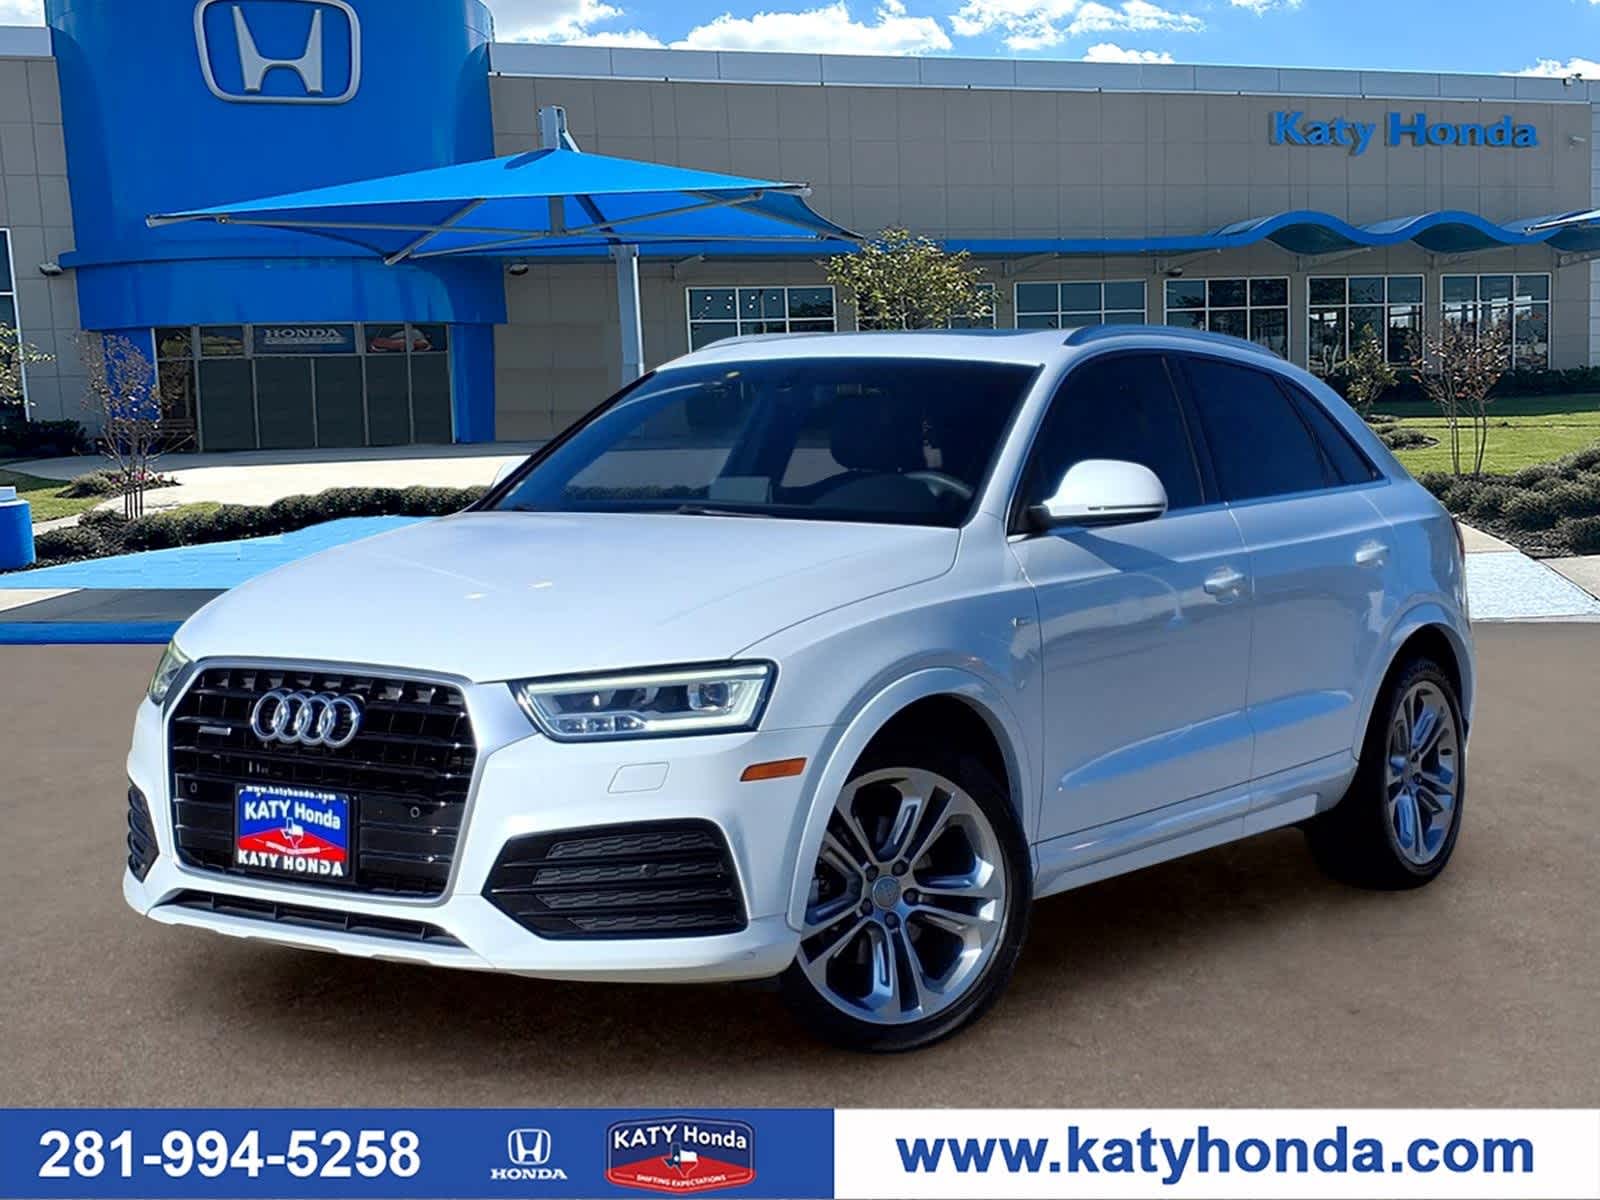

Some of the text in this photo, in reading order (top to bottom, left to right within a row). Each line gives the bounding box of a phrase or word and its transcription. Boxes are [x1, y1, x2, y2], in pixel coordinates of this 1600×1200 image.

[1272, 111, 1540, 156] Katy Honda
[265, 328, 340, 337] HONDA
[245, 800, 341, 830] KATY Honda
[238, 850, 343, 876] KATY HONDA
